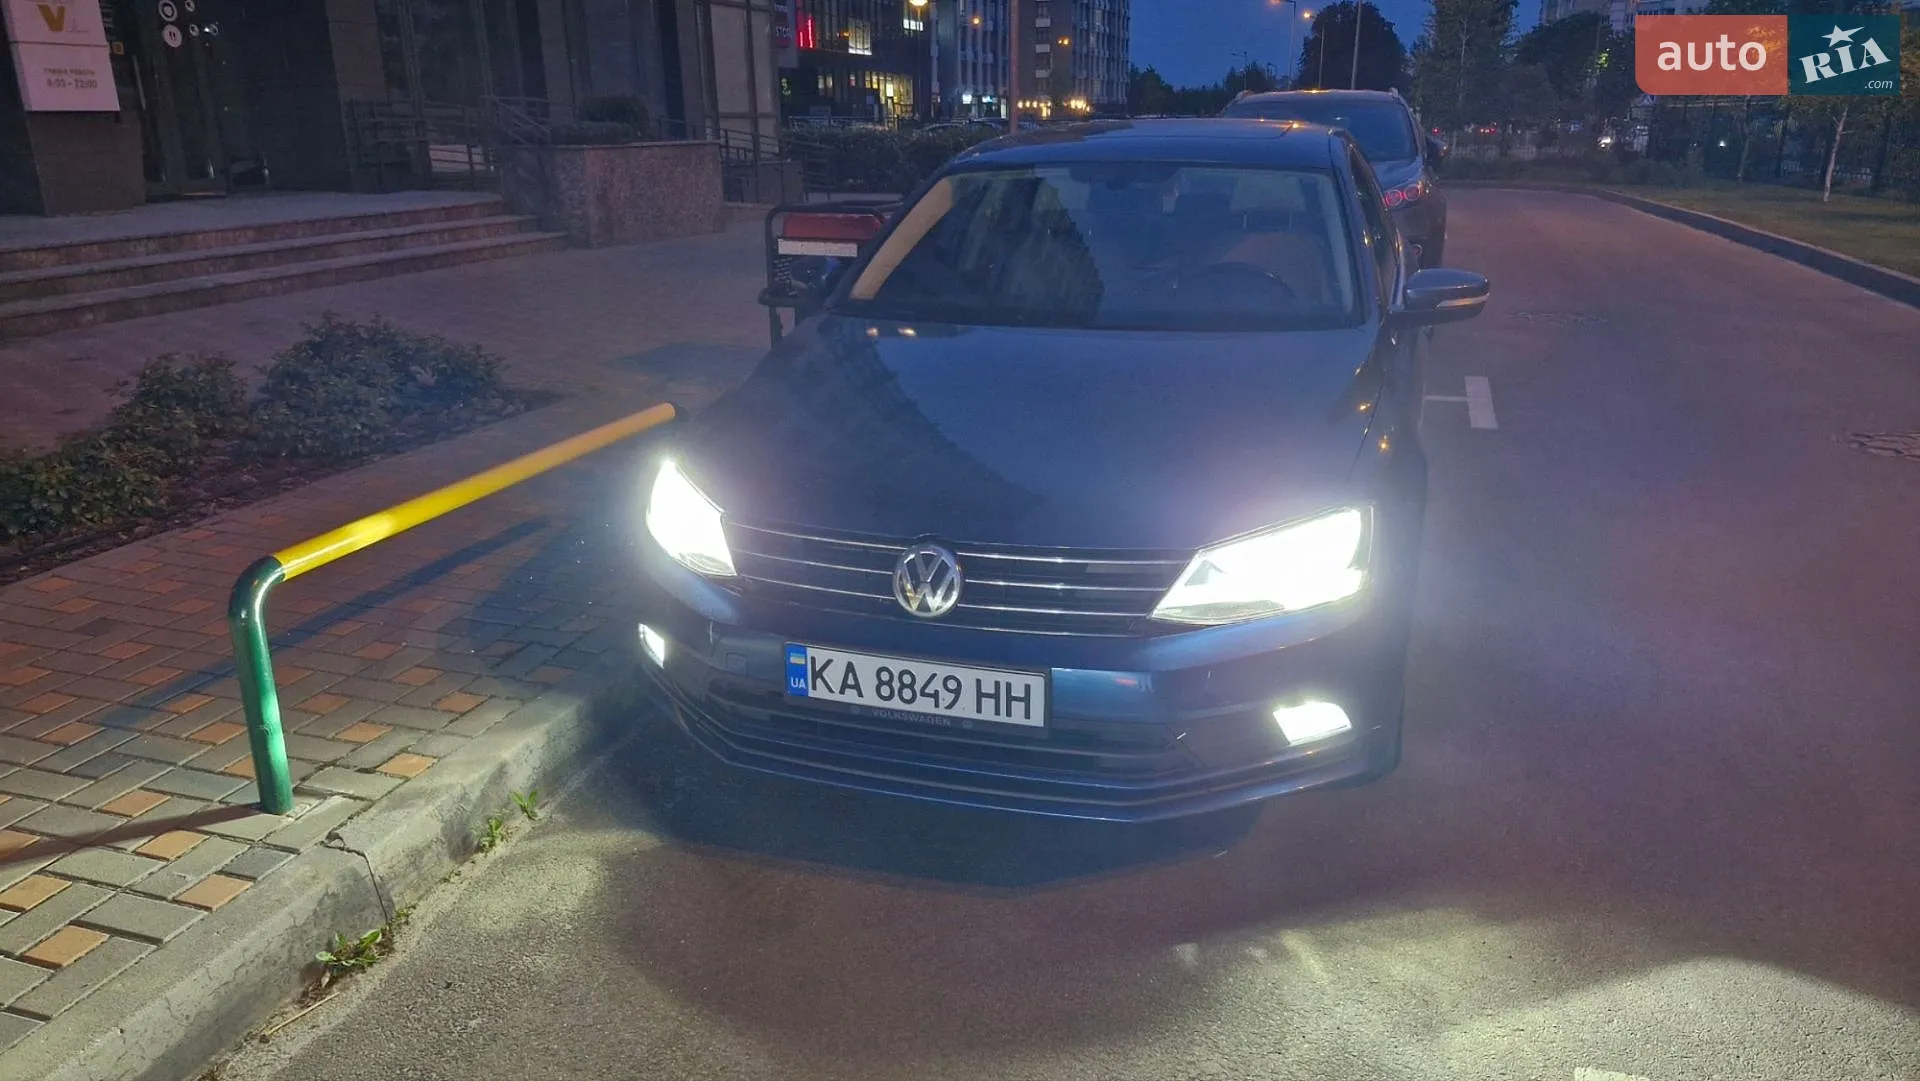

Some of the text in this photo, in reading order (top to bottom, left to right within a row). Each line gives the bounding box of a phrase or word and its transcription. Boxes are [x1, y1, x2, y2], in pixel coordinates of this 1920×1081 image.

[790, 676, 807, 690] UA
[809, 655, 1031, 720] KA 8849 HH
